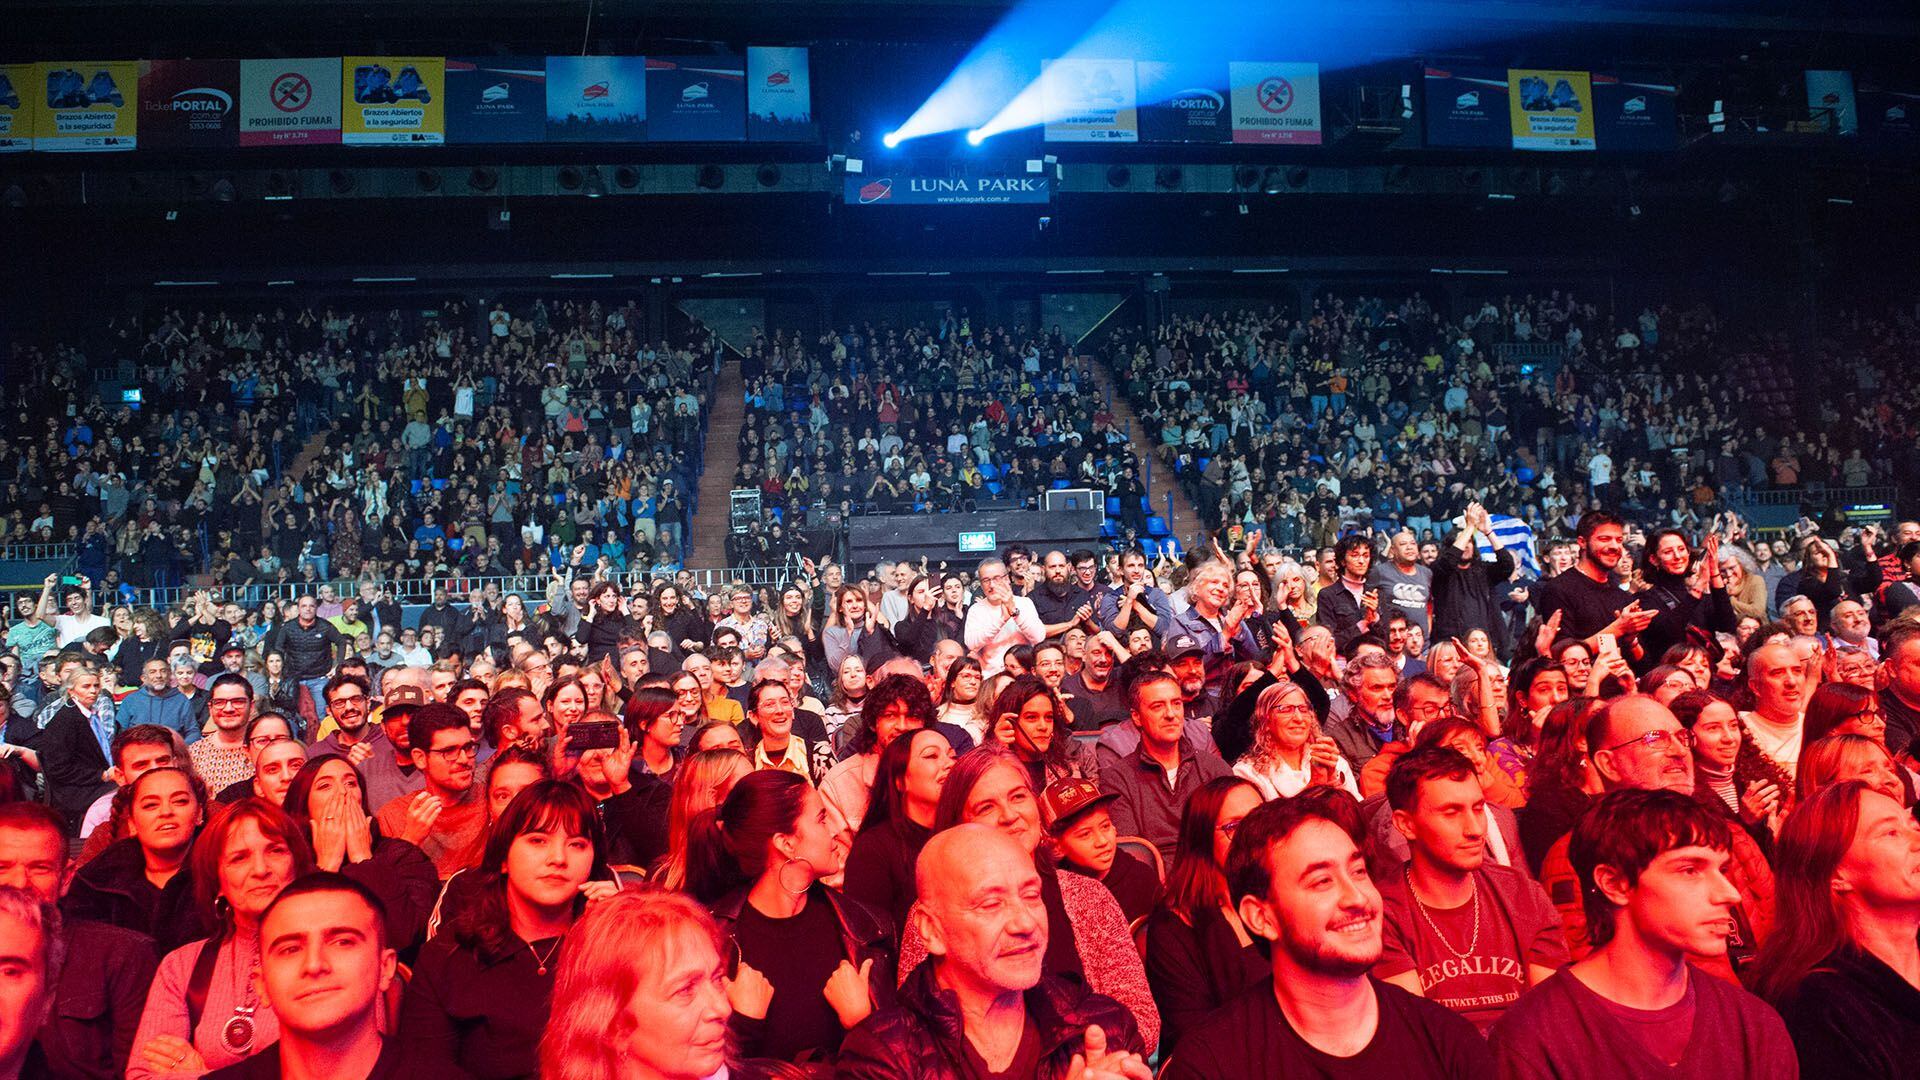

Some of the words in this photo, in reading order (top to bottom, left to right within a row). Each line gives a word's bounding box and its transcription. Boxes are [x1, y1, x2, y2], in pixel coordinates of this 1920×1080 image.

[85, 113, 116, 121] Abiertos
[249, 116, 298, 127] PROHIBIDO
[300, 115, 333, 125] FUMAR
[1239, 117, 1283, 126] PROHIBIDO
[1285, 117, 1313, 126] FUMAR
[73, 121, 113, 132] seguridad.
[910, 178, 969, 192] LUNA
[978, 178, 1035, 192] PARK
[937, 195, 1011, 204] www.lunapark.com.ar
[1419, 956, 1525, 992] LEGALIZE
[1479, 995, 1504, 1005] THIS
